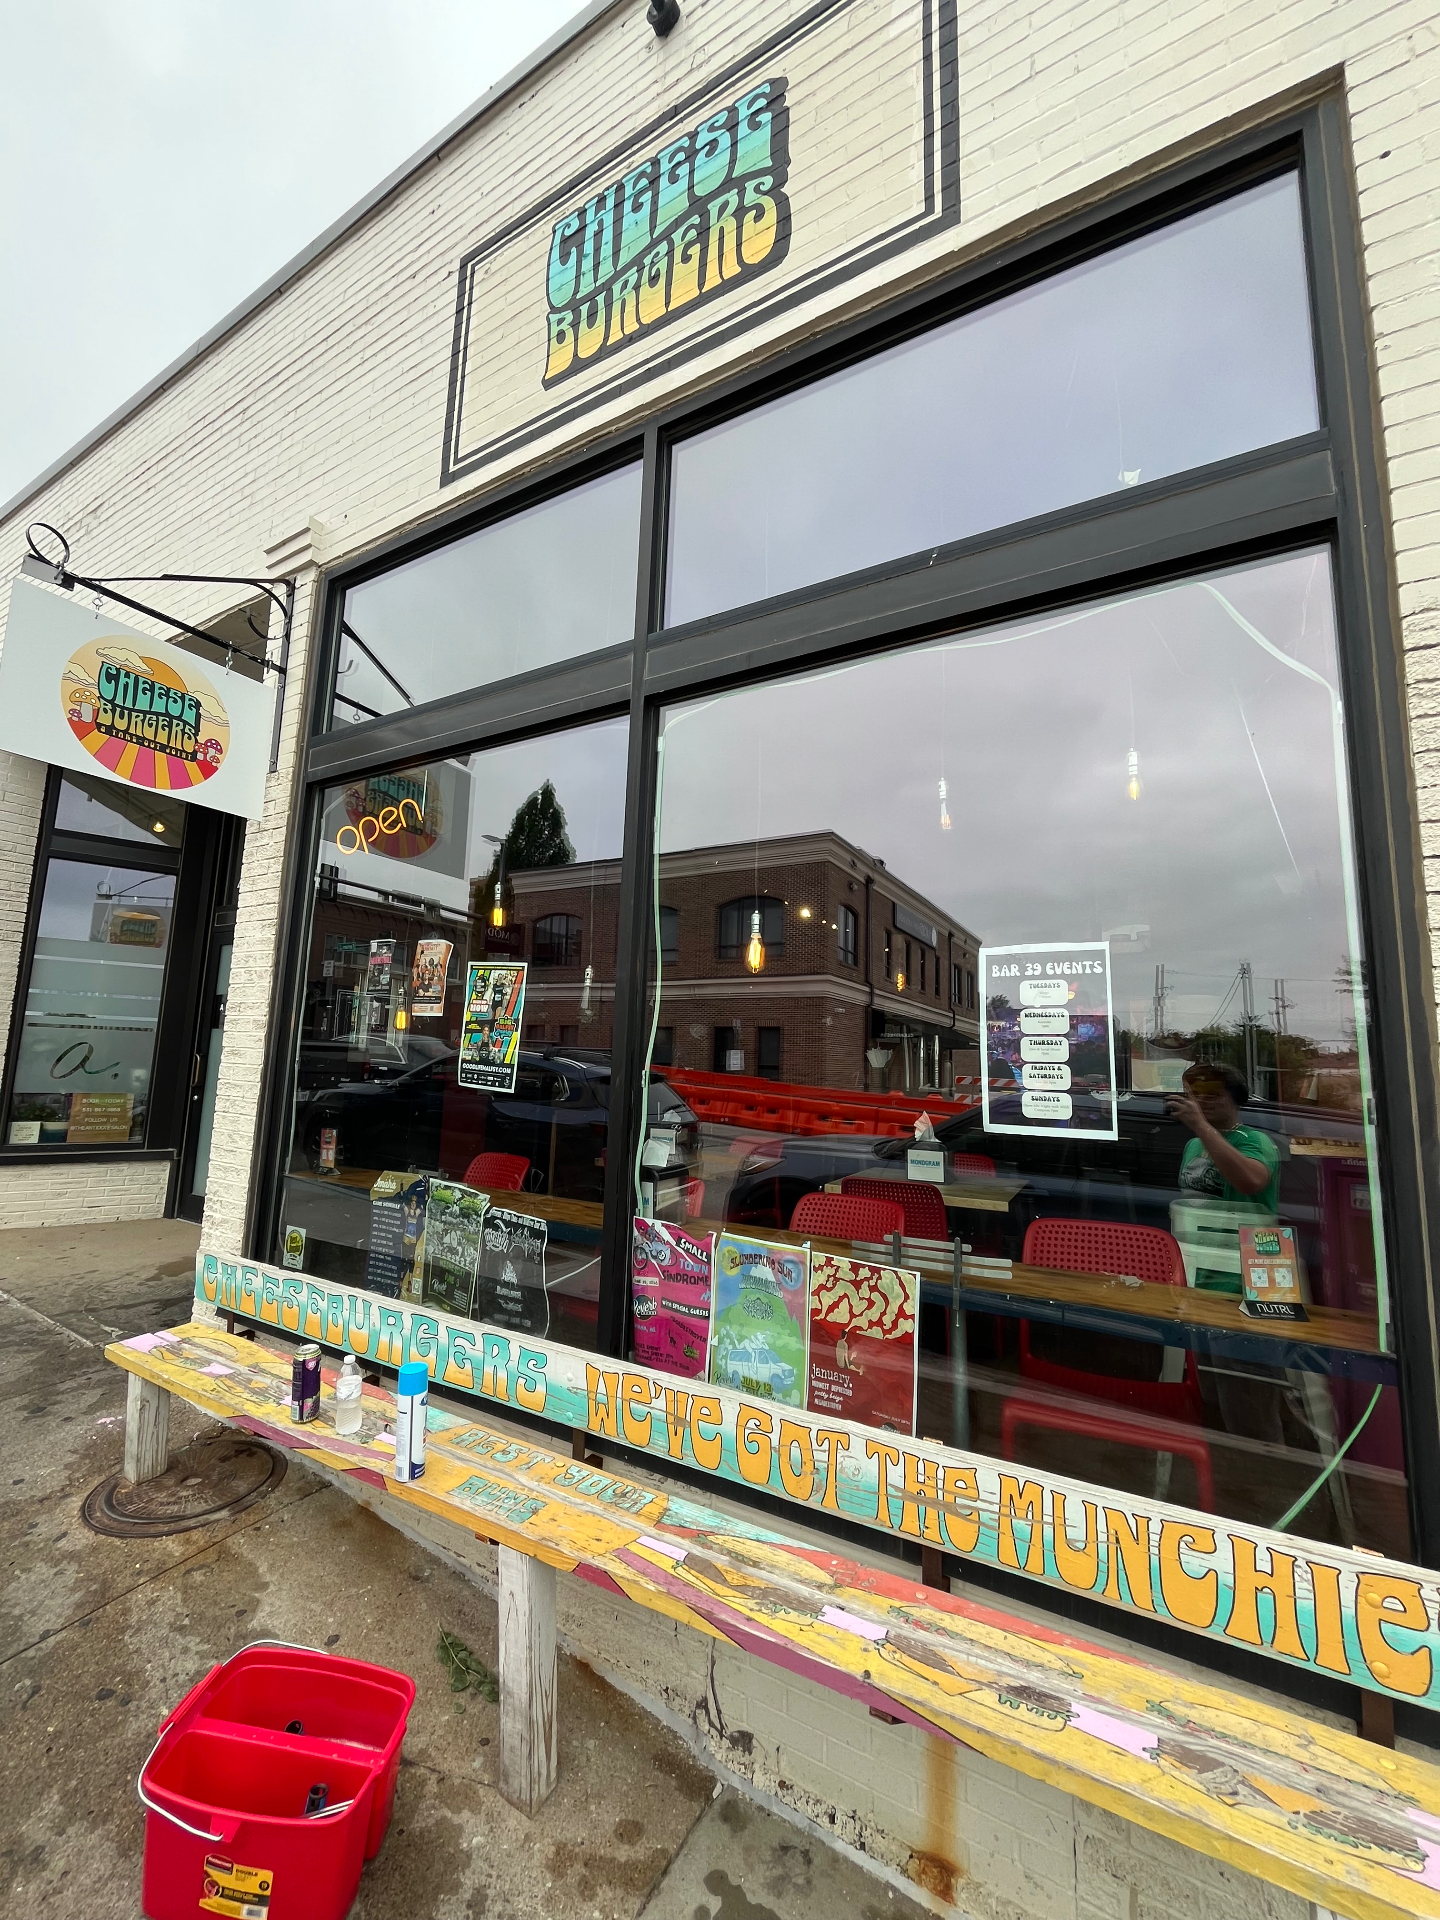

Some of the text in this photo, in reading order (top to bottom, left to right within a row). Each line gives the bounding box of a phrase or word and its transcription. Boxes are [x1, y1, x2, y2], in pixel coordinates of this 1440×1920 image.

[547, 82, 772, 308] CHEESE
[545, 175, 777, 380] BURGERS
[99, 662, 197, 727] CHEESE
[97, 697, 196, 753] BURGERS
[166, 748, 192, 760] JOINT
[335, 798, 424, 855] open
[991, 960, 1103, 978] BAR 39 EVENTS
[910, 1159, 940, 1167] MONOGRAM
[679, 1239, 708, 1262] SMALL
[679, 1258, 709, 1275] TOWN
[729, 1253, 793, 1283] SLUMBERING SUN
[633, 1296, 658, 1317] Reverb
[672, 1302, 689, 1313] SPECIAL
[689, 1308, 709, 1317] GUESTS
[811, 1363, 853, 1388] january.
[203, 1254, 547, 1413] CHEESEBURGERS
[735, 1402, 850, 1510] GOT
[997, 1472, 1440, 1698] MUNCHIE
[450, 1428, 659, 1514] REST YOUR
[447, 1475, 549, 1524] BUNS
